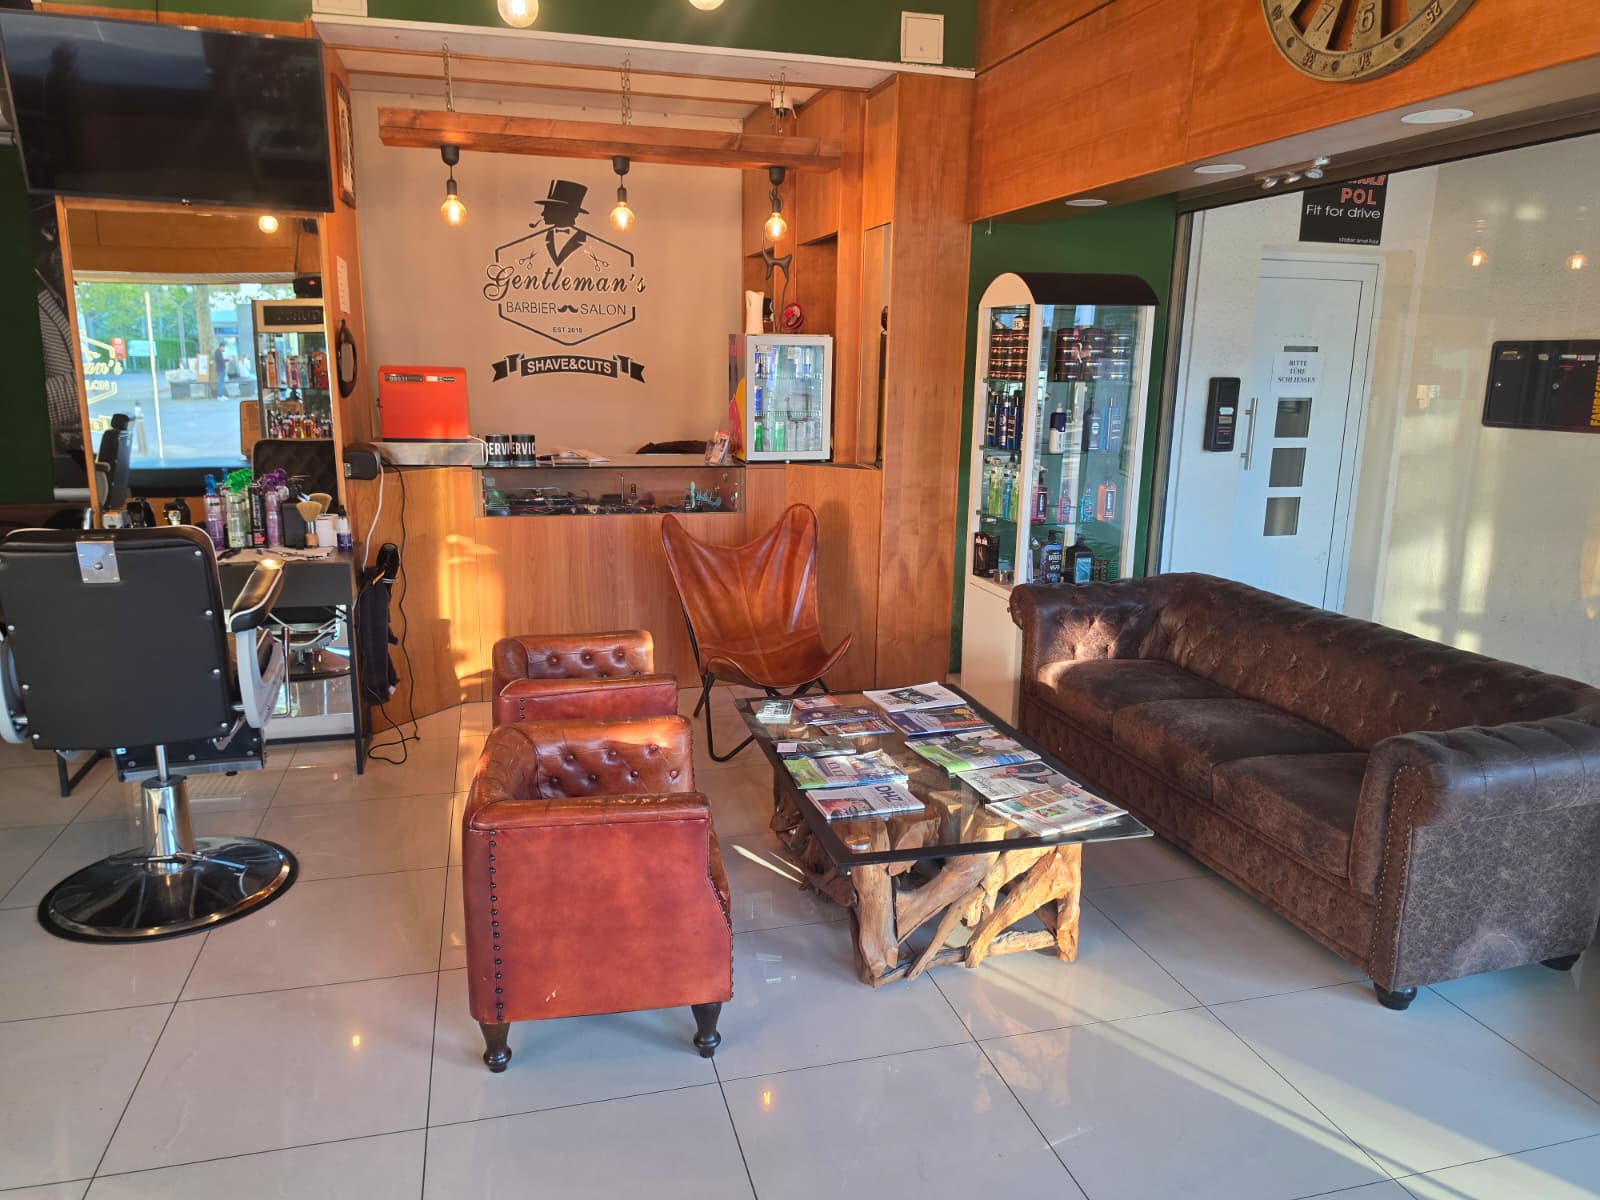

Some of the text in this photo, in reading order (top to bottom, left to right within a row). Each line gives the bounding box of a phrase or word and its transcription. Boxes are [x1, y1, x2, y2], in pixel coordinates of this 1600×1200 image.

[1340, 187, 1377, 205] POL
[1306, 204, 1381, 219] Fit for drive
[483, 264, 646, 301] Gentleman's
[506, 302, 626, 316] BARBIER SALON
[527, 358, 612, 374] SHAVE&CUTS
